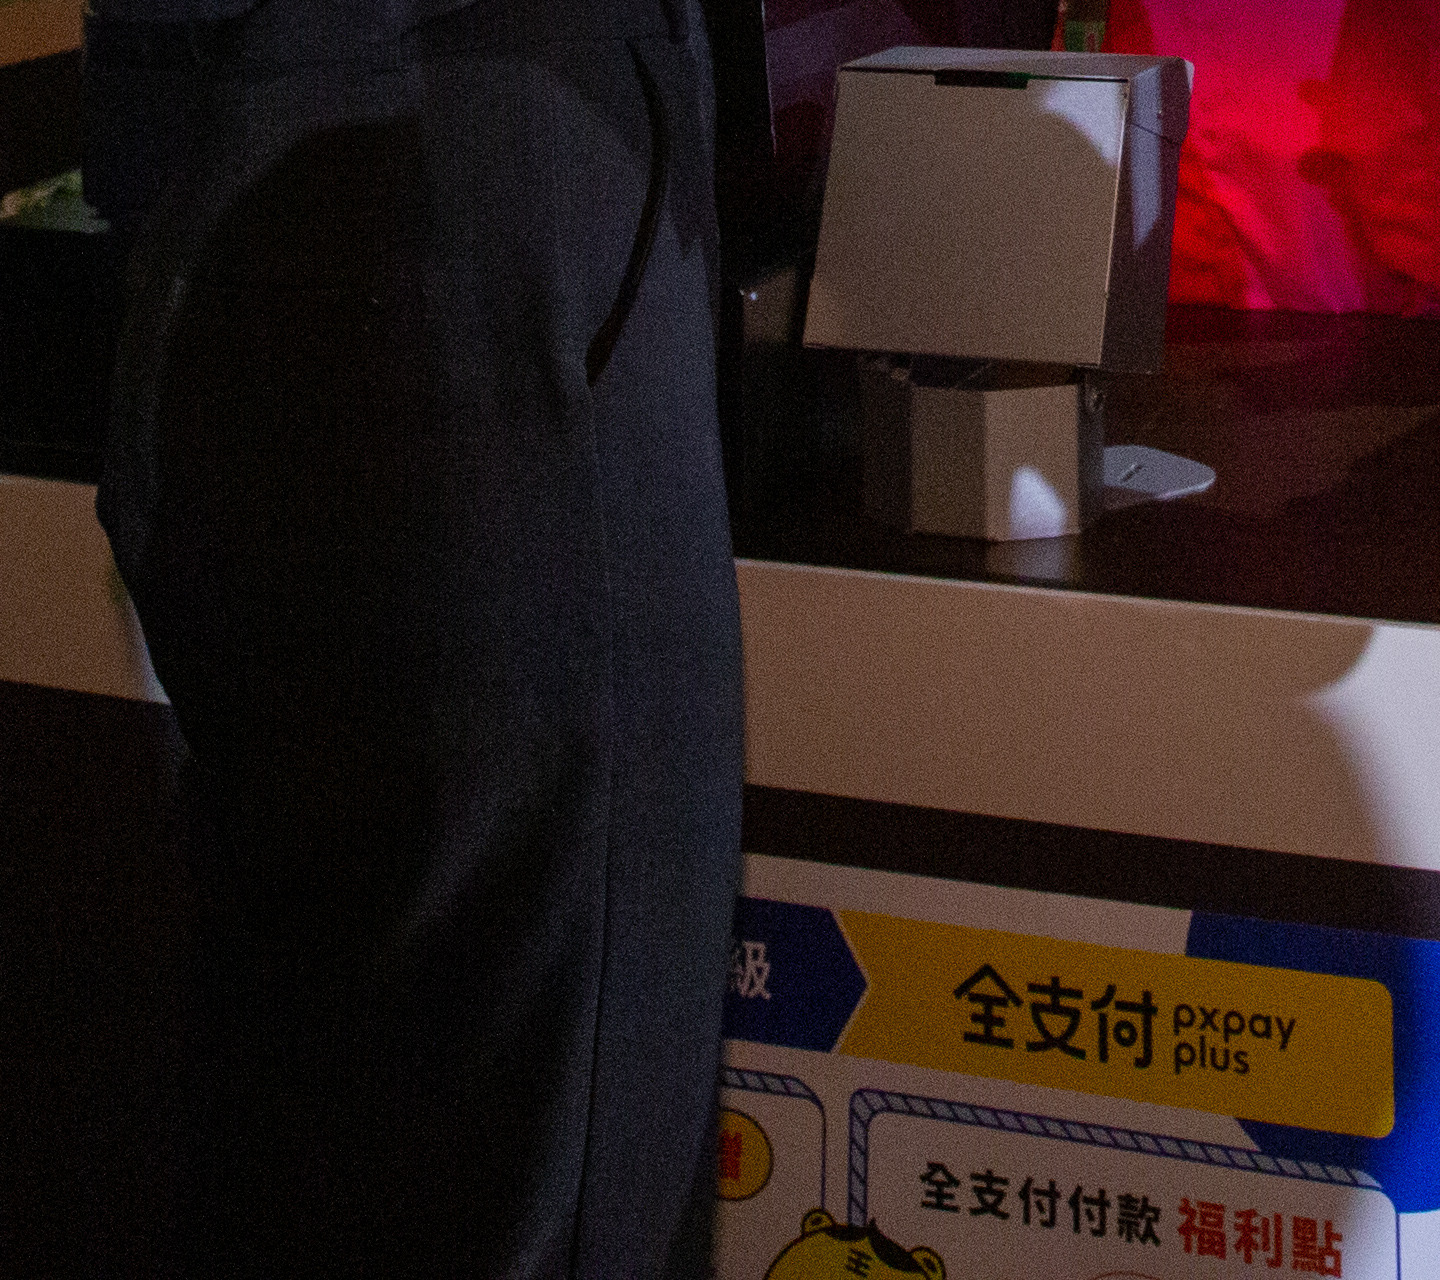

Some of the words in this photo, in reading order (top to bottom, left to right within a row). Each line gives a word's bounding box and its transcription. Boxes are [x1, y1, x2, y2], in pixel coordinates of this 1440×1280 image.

[953, 962, 1159, 1072] 全支付
[1172, 1001, 1297, 1052] pxpay
[1172, 1034, 1252, 1077] plus
[918, 1161, 1162, 1249] 全支付付款
[1178, 1196, 1345, 1278] 福利點
